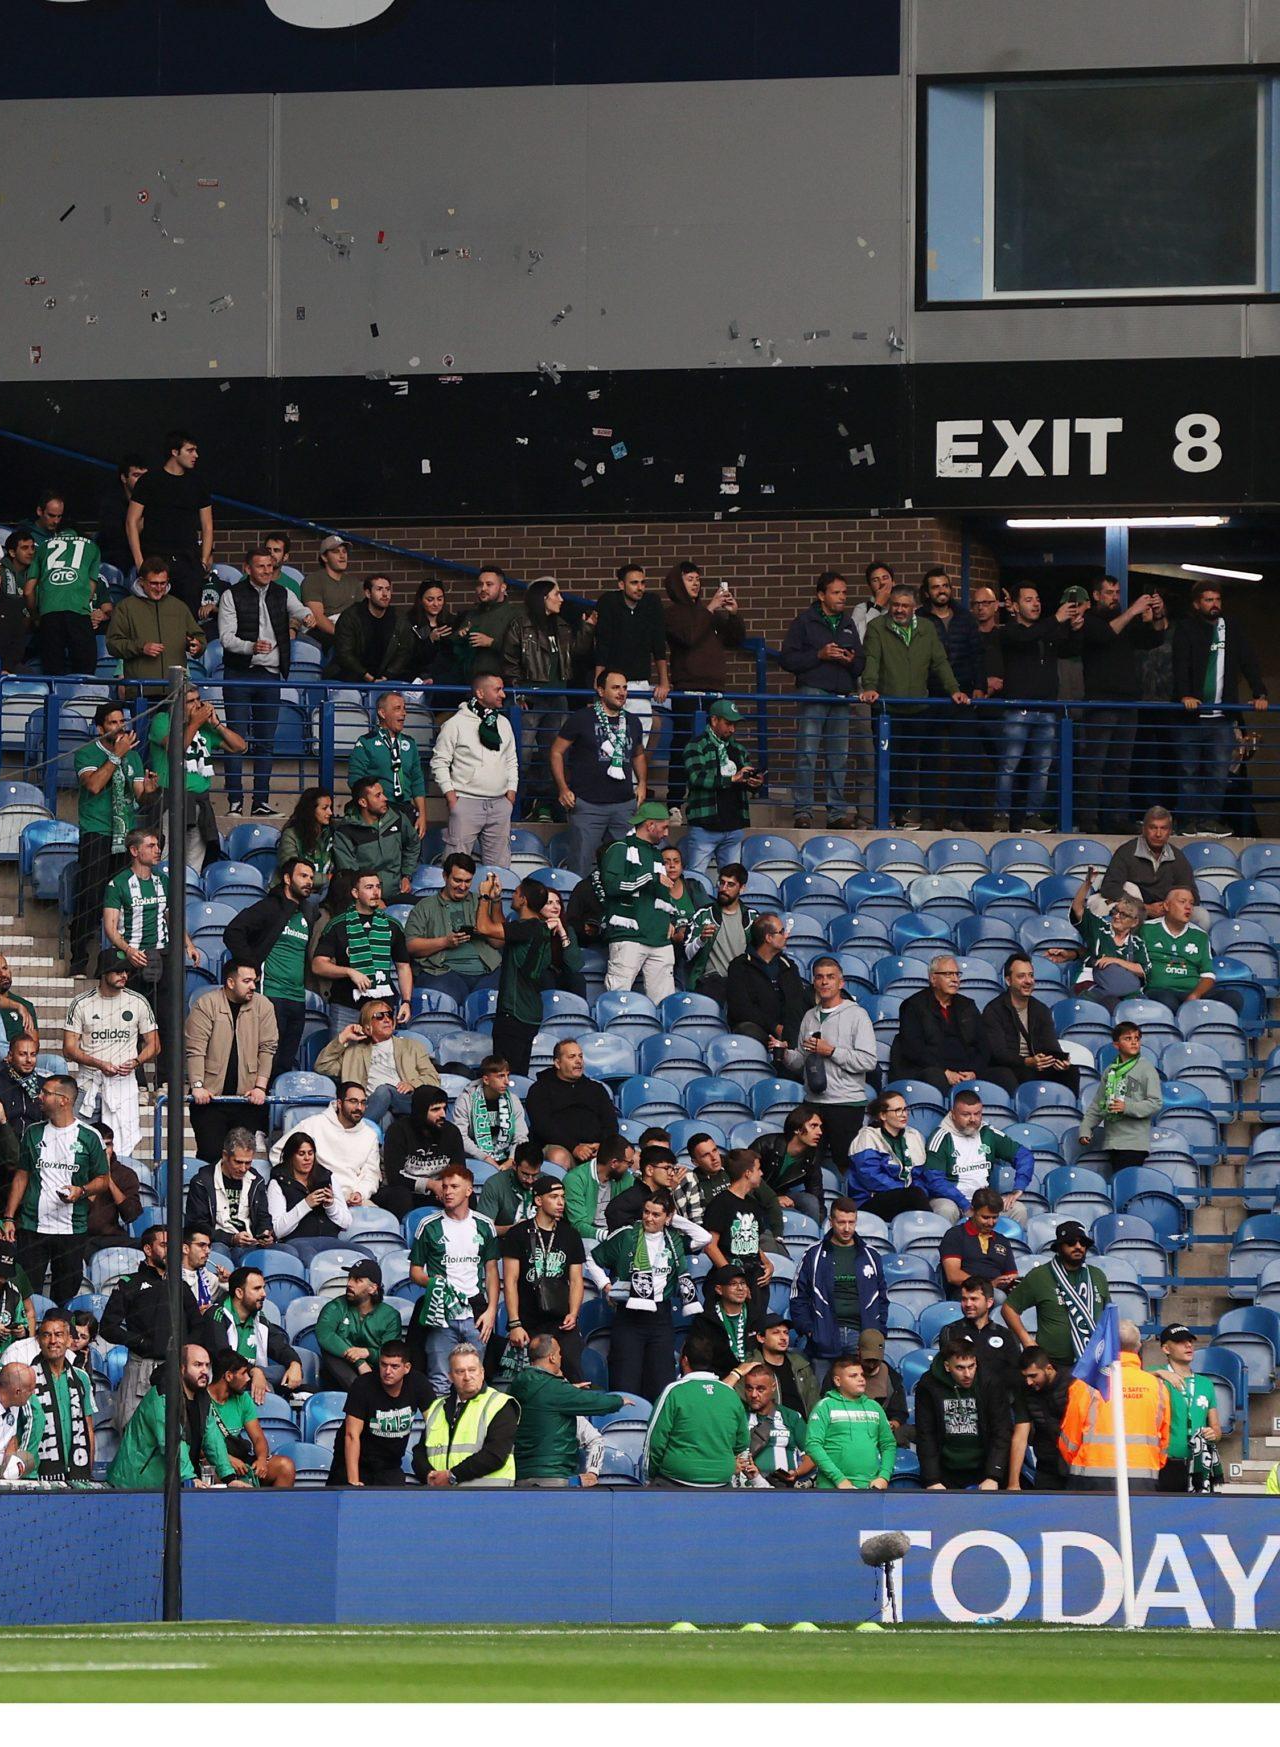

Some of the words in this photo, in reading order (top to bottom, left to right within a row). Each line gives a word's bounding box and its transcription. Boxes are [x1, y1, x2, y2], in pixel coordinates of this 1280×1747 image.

[935, 417, 1123, 477] EXIT
[1173, 413, 1222, 473] 8
[47, 540, 85, 570] 21
[91, 1029, 130, 1040] adidas
[35, 1158, 81, 1173] Stoiximan
[951, 1161, 992, 1175] Stoiximan
[440, 1253, 481, 1266] Stoiximan
[1232, 1465, 1241, 1475] D
[859, 1529, 1280, 1629] TODAY
